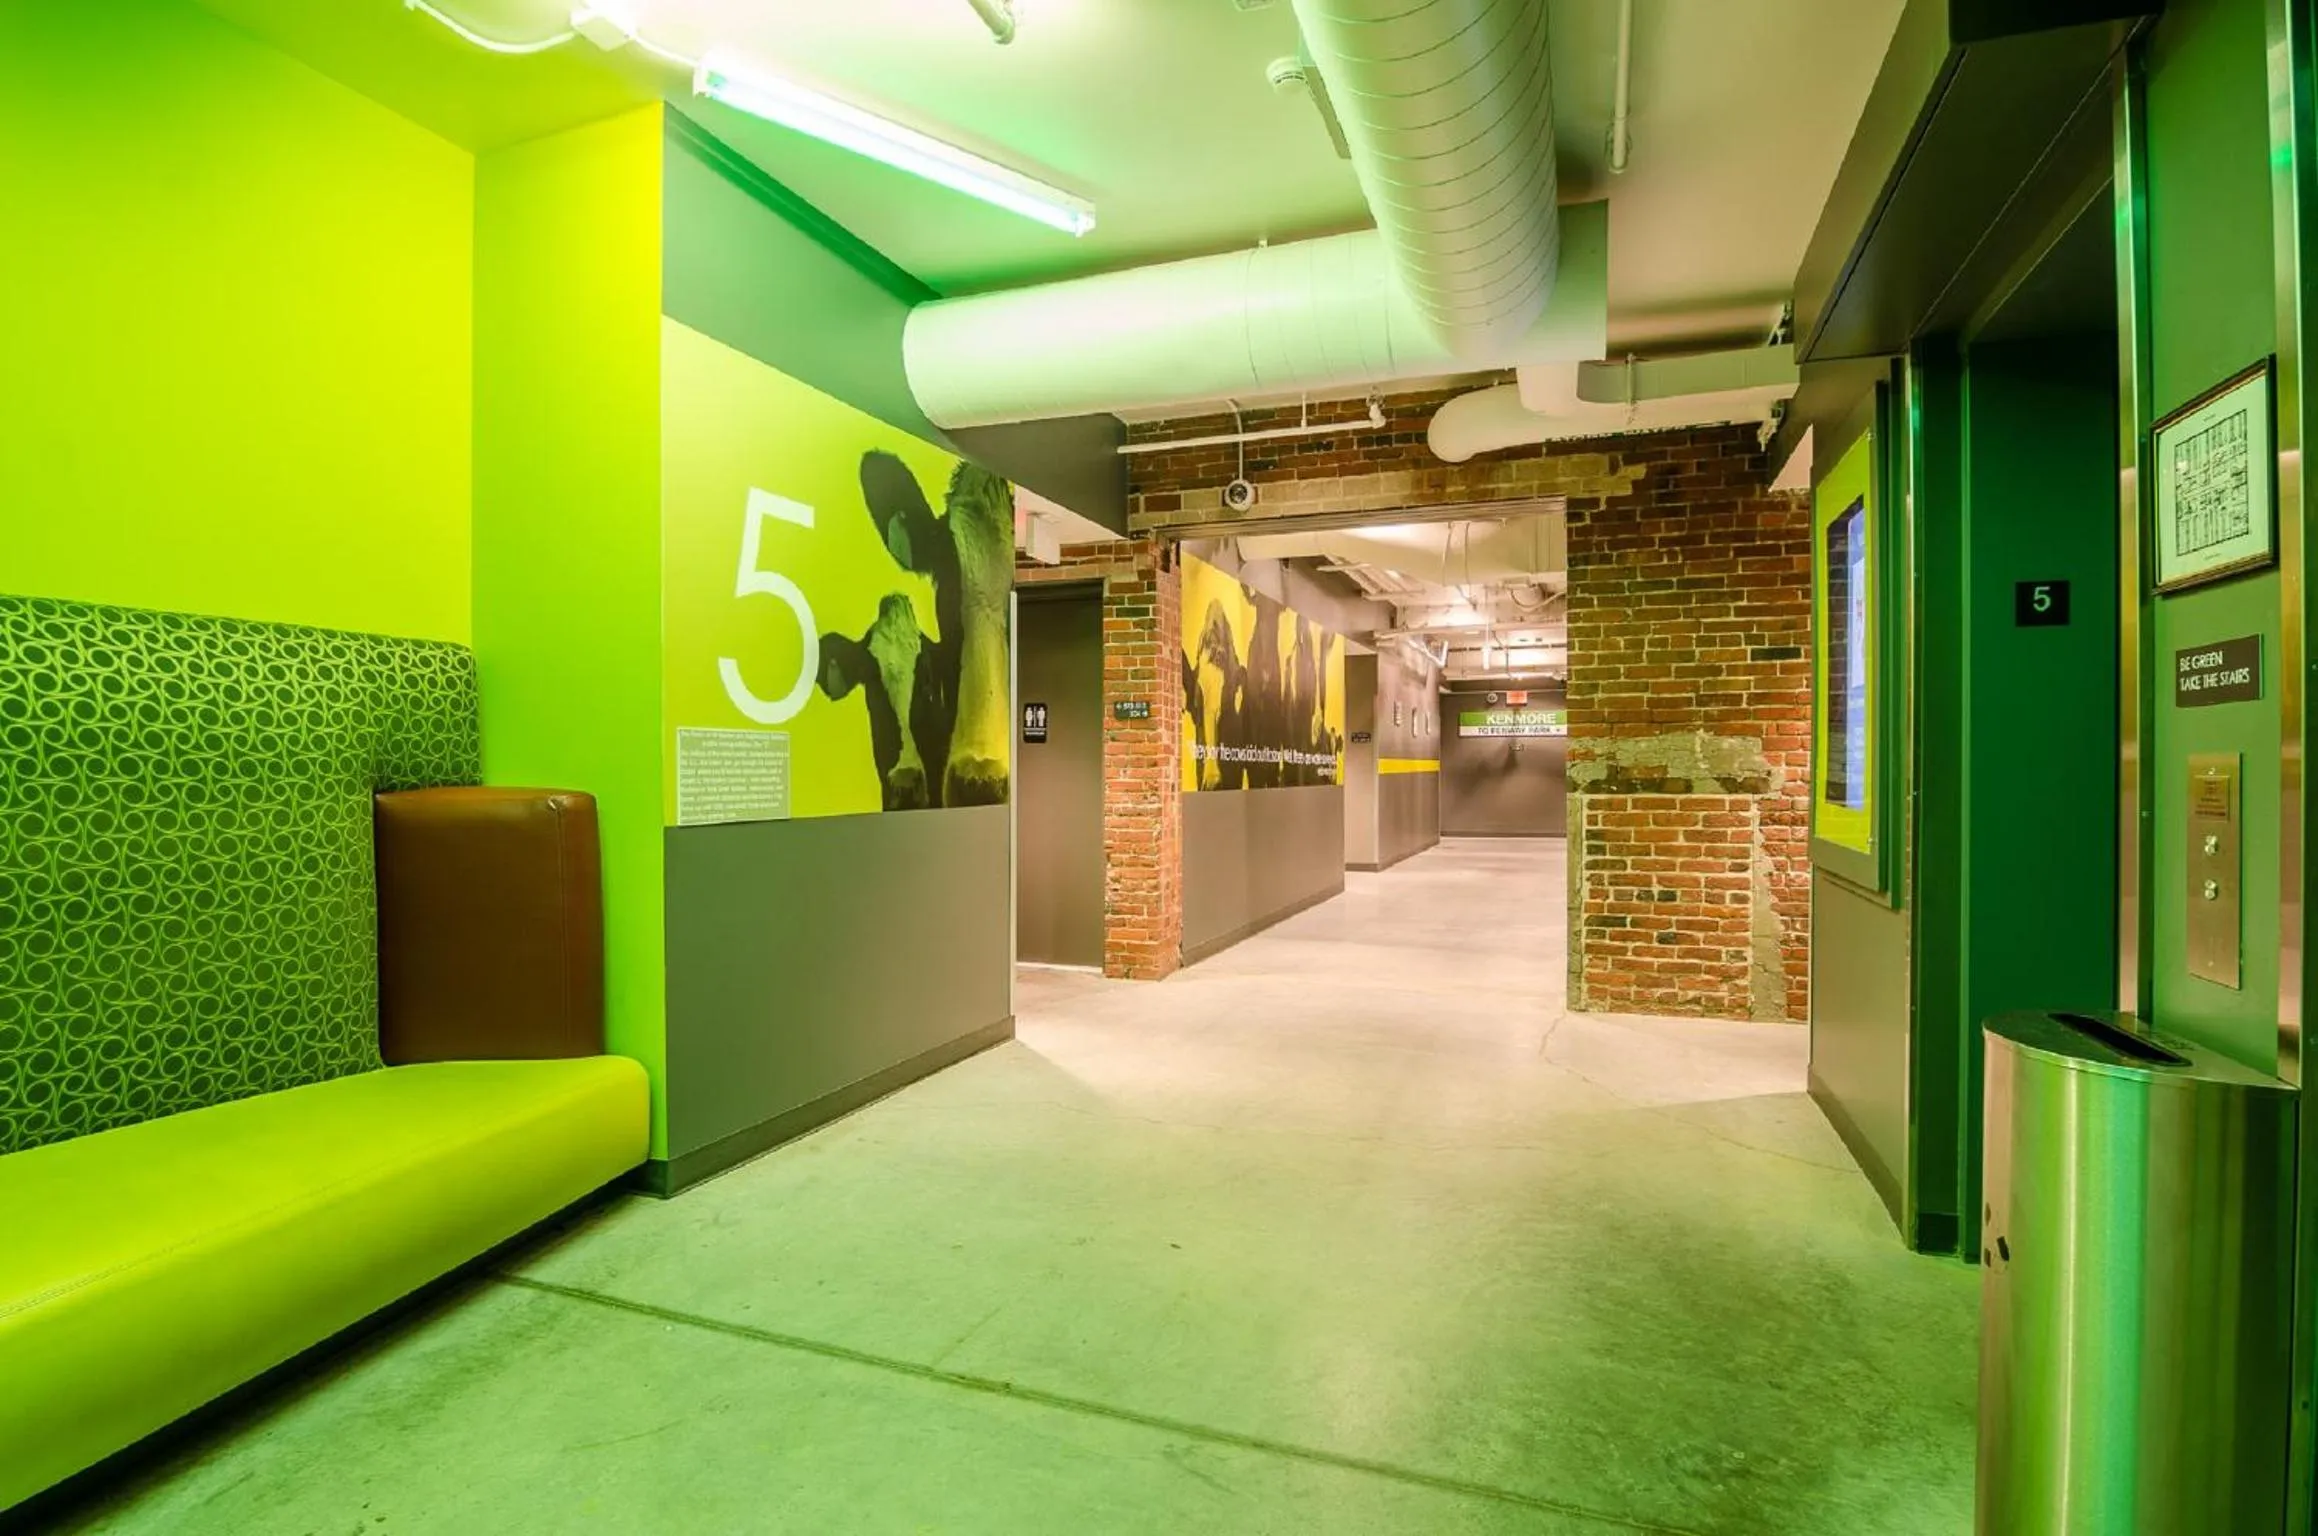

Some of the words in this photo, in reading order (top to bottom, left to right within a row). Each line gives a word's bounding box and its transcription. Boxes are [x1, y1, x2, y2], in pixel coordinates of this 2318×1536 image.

[718, 486, 820, 725] 5
[2033, 586, 2051, 612] 5
[2179, 656, 2191, 672] BE
[2191, 650, 2223, 669] GREEN
[2179, 675, 2202, 692] TAKE
[2203, 672, 2218, 689] THE
[2219, 667, 2249, 686] STAIRS
[1486, 713, 1556, 724] KENMORE
[1478, 727, 1488, 735] TO
